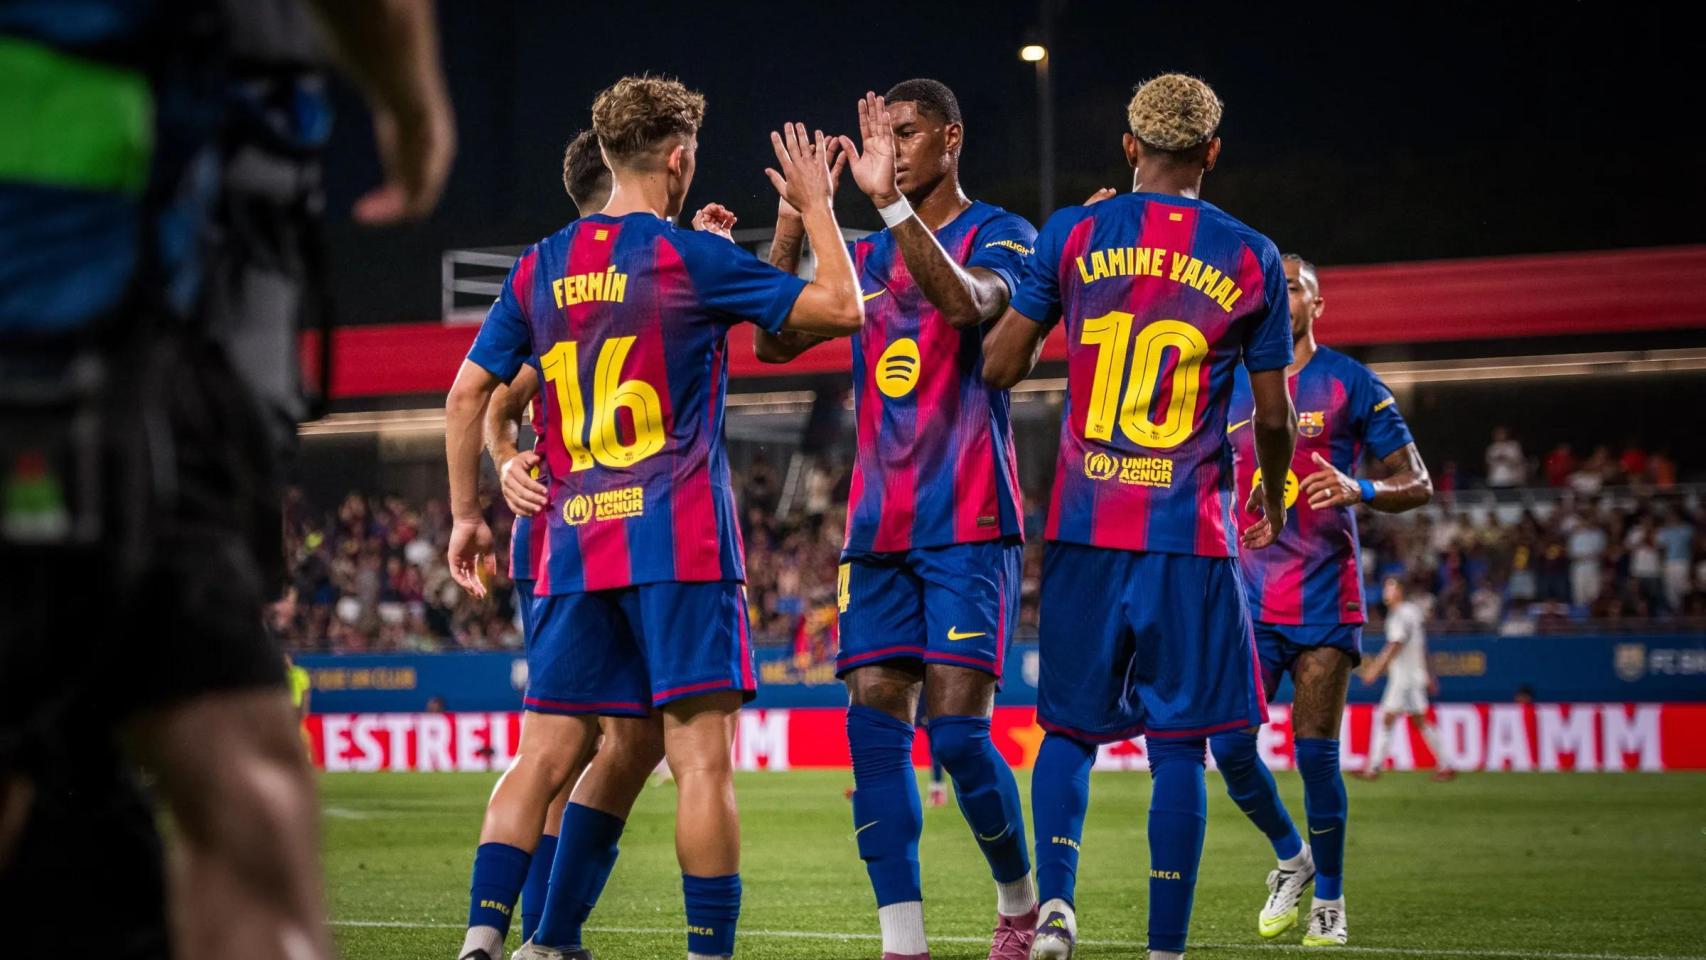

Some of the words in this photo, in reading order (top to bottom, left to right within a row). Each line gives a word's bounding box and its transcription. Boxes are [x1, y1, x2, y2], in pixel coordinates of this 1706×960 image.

[552, 264, 628, 309] FERMÍN
[1076, 248, 1166, 284] LAMINE
[1169, 252, 1243, 313] YAMAL
[540, 336, 666, 472] 16
[1081, 311, 1209, 448] 10
[1119, 468, 1172, 483] ACNUR
[1121, 457, 1173, 471] UNHCR
[594, 486, 643, 504] UNHCR
[595, 499, 643, 517] ACNUR
[323, 713, 524, 772] ESTREL
[1439, 703, 1664, 772] DAMM
